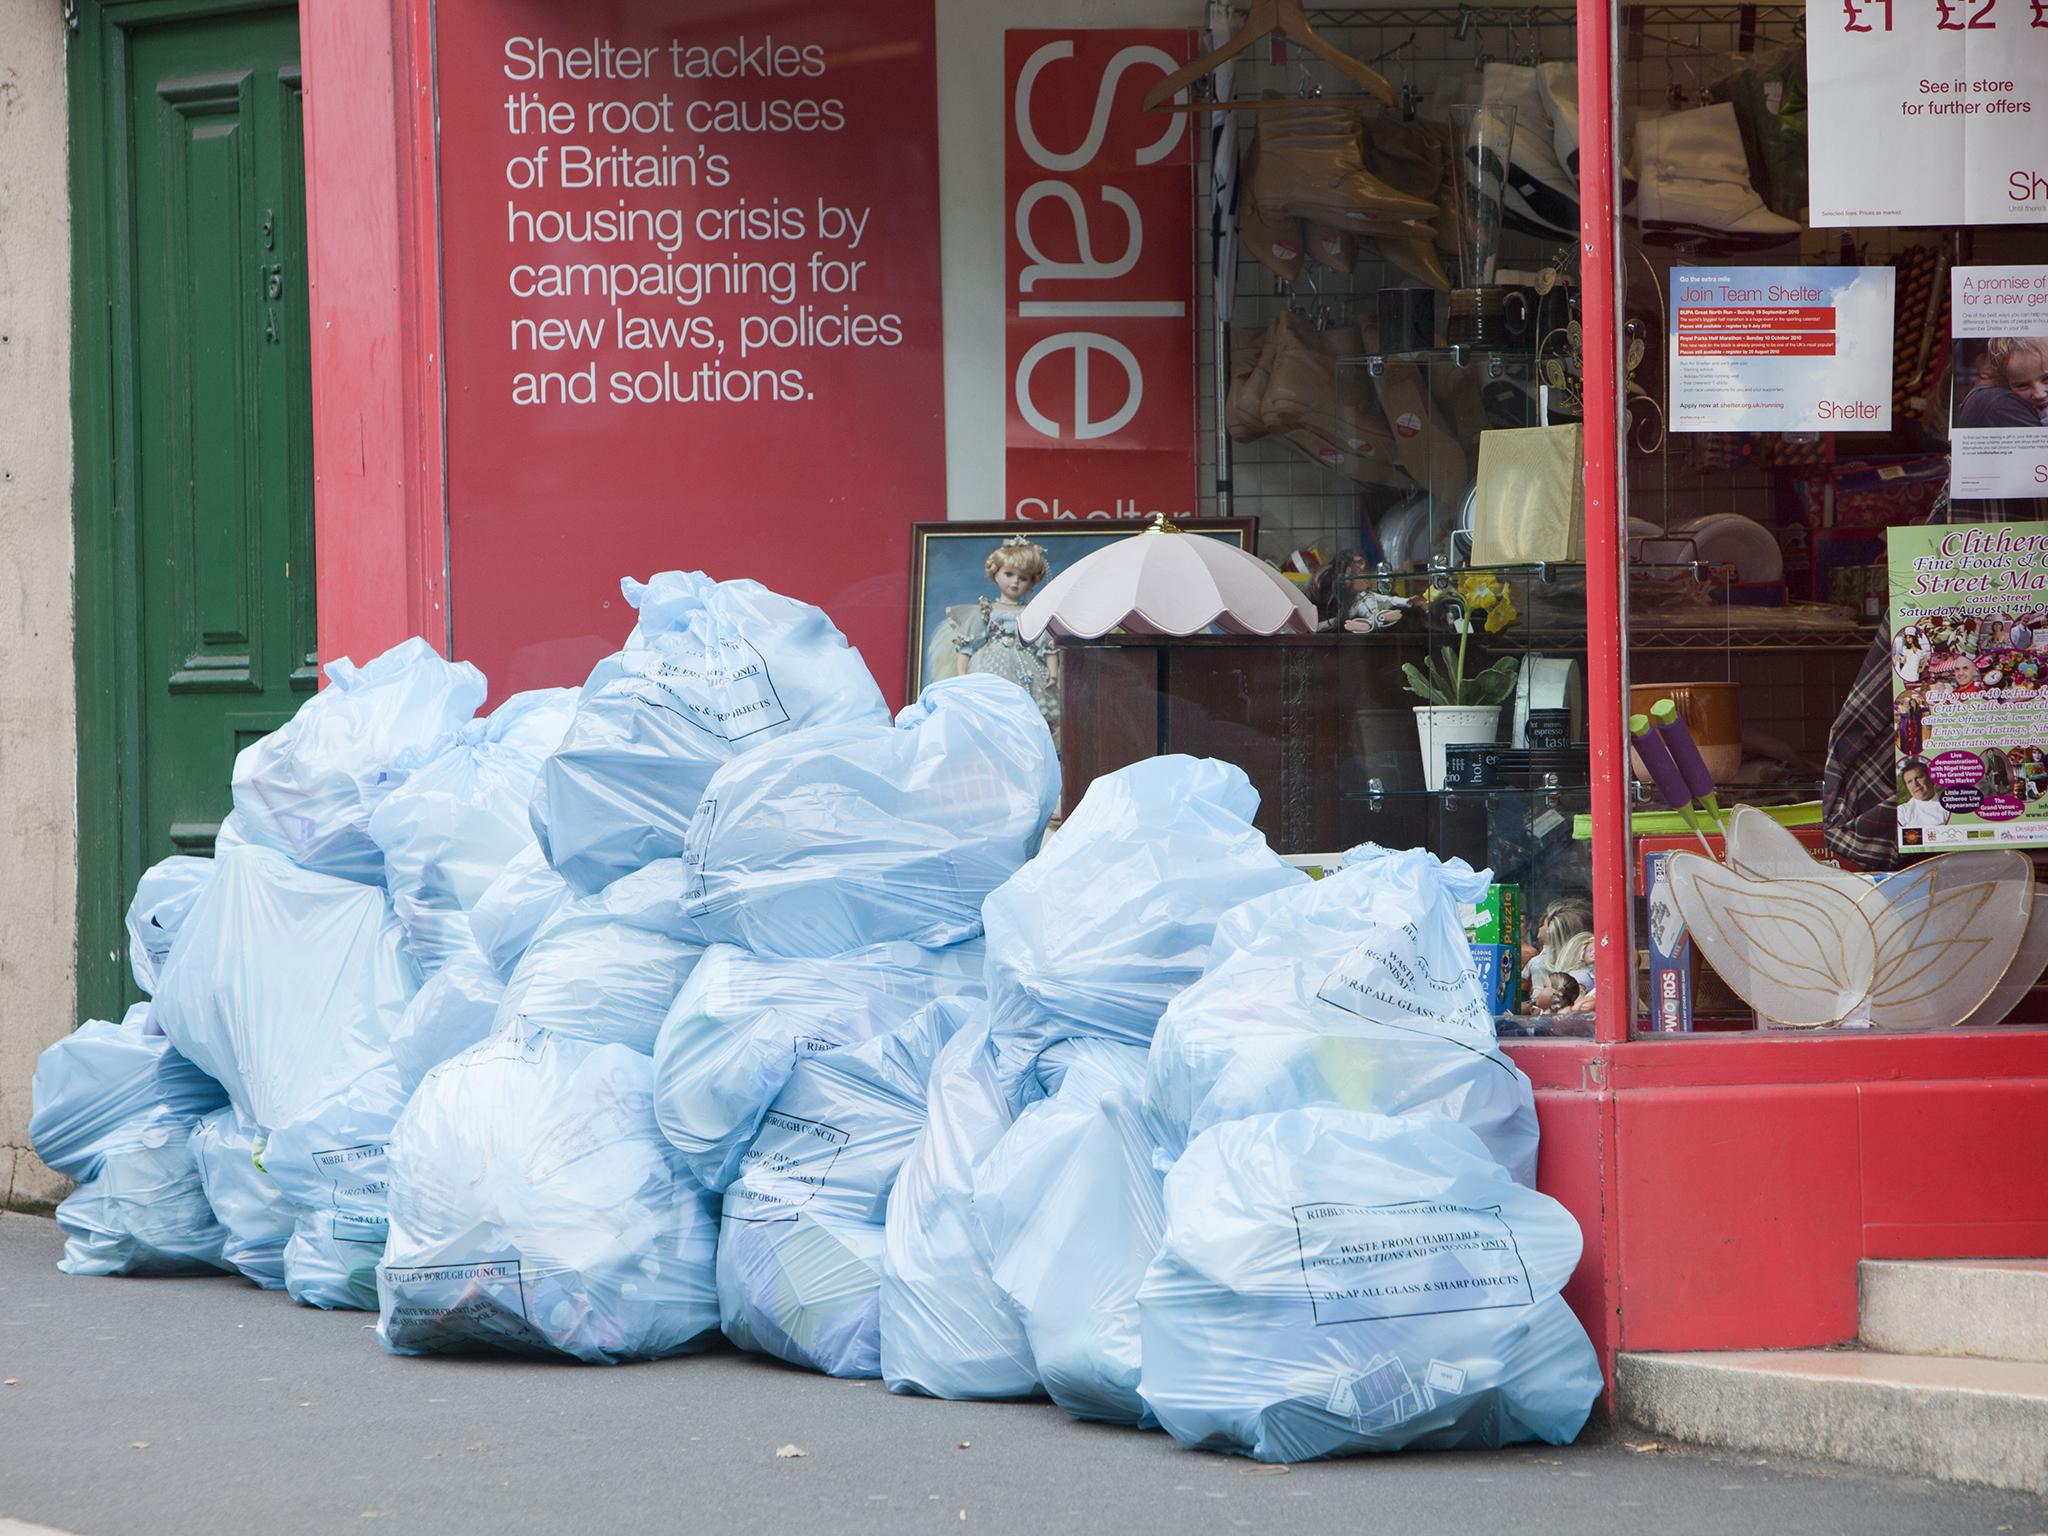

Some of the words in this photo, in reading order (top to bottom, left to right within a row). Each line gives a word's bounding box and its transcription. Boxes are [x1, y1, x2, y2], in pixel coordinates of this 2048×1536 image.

[503, 36, 658, 80] Shelter
[668, 34, 826, 78] tackles
[1919, 80, 1949, 93] See
[1955, 79, 1967, 92] in
[1973, 80, 2013, 93] store
[504, 93, 575, 134] the
[587, 94, 674, 133] root
[685, 97, 846, 131] causes
[1902, 101, 1924, 115] for
[1928, 100, 1981, 114] further
[1986, 99, 2031, 113] offers
[506, 146, 548, 189] of
[560, 145, 730, 188] Britain's
[507, 200, 683, 252] housing
[695, 197, 805, 240] crisis
[818, 197, 871, 249] by
[1015, 39, 1189, 440] Sale
[509, 252, 796, 305] campaigning
[808, 251, 866, 294] for
[1963, 276, 1974, 289] A
[1978, 276, 2030, 292] promise
[2034, 275, 2047, 288] of
[1680, 286, 1713, 302] Join
[1718, 286, 1762, 302] Team
[1768, 285, 1824, 301] Shelter
[1963, 292, 1980, 304] for
[1983, 294, 1992, 304] a
[1996, 294, 2023, 304] new
[511, 318, 605, 350] new
[616, 308, 725, 356] laws,
[740, 305, 903, 357] policies
[512, 361, 596, 405] and
[609, 360, 814, 403] solutions.
[1817, 400, 1881, 419] Shelter
[1913, 557, 1953, 571] Fine
[1959, 554, 2012, 569] Foods
[1909, 573, 1991, 597] Street
[1965, 595, 1998, 604] Castle
[2000, 593, 2031, 602] Street
[1899, 607, 1959, 618] Saturday
[1958, 604, 2001, 617] August
[2005, 603, 2032, 613] 14th
[733, 664, 760, 681] ONLY
[1933, 703, 1967, 715] Crafts
[1969, 700, 1999, 712] Stalls
[1398, 1000, 1436, 1019] GLASS
[1341, 1243, 1378, 1254] WASTE
[1382, 1236, 1413, 1251] FROM
[1415, 1231, 1481, 1246] CHARITABLE
[1481, 1239, 1509, 1251] ONLY
[424, 1271, 463, 1281] BOROUGH
[465, 1267, 508, 1279] COUNCIL
[1361, 1288, 1384, 1298] ALL
[1385, 1284, 1421, 1295] GLASS
[1423, 1283, 1432, 1292] &
[1434, 1280, 1470, 1291] SHARP
[1472, 1275, 1519, 1288] OBJECTS
